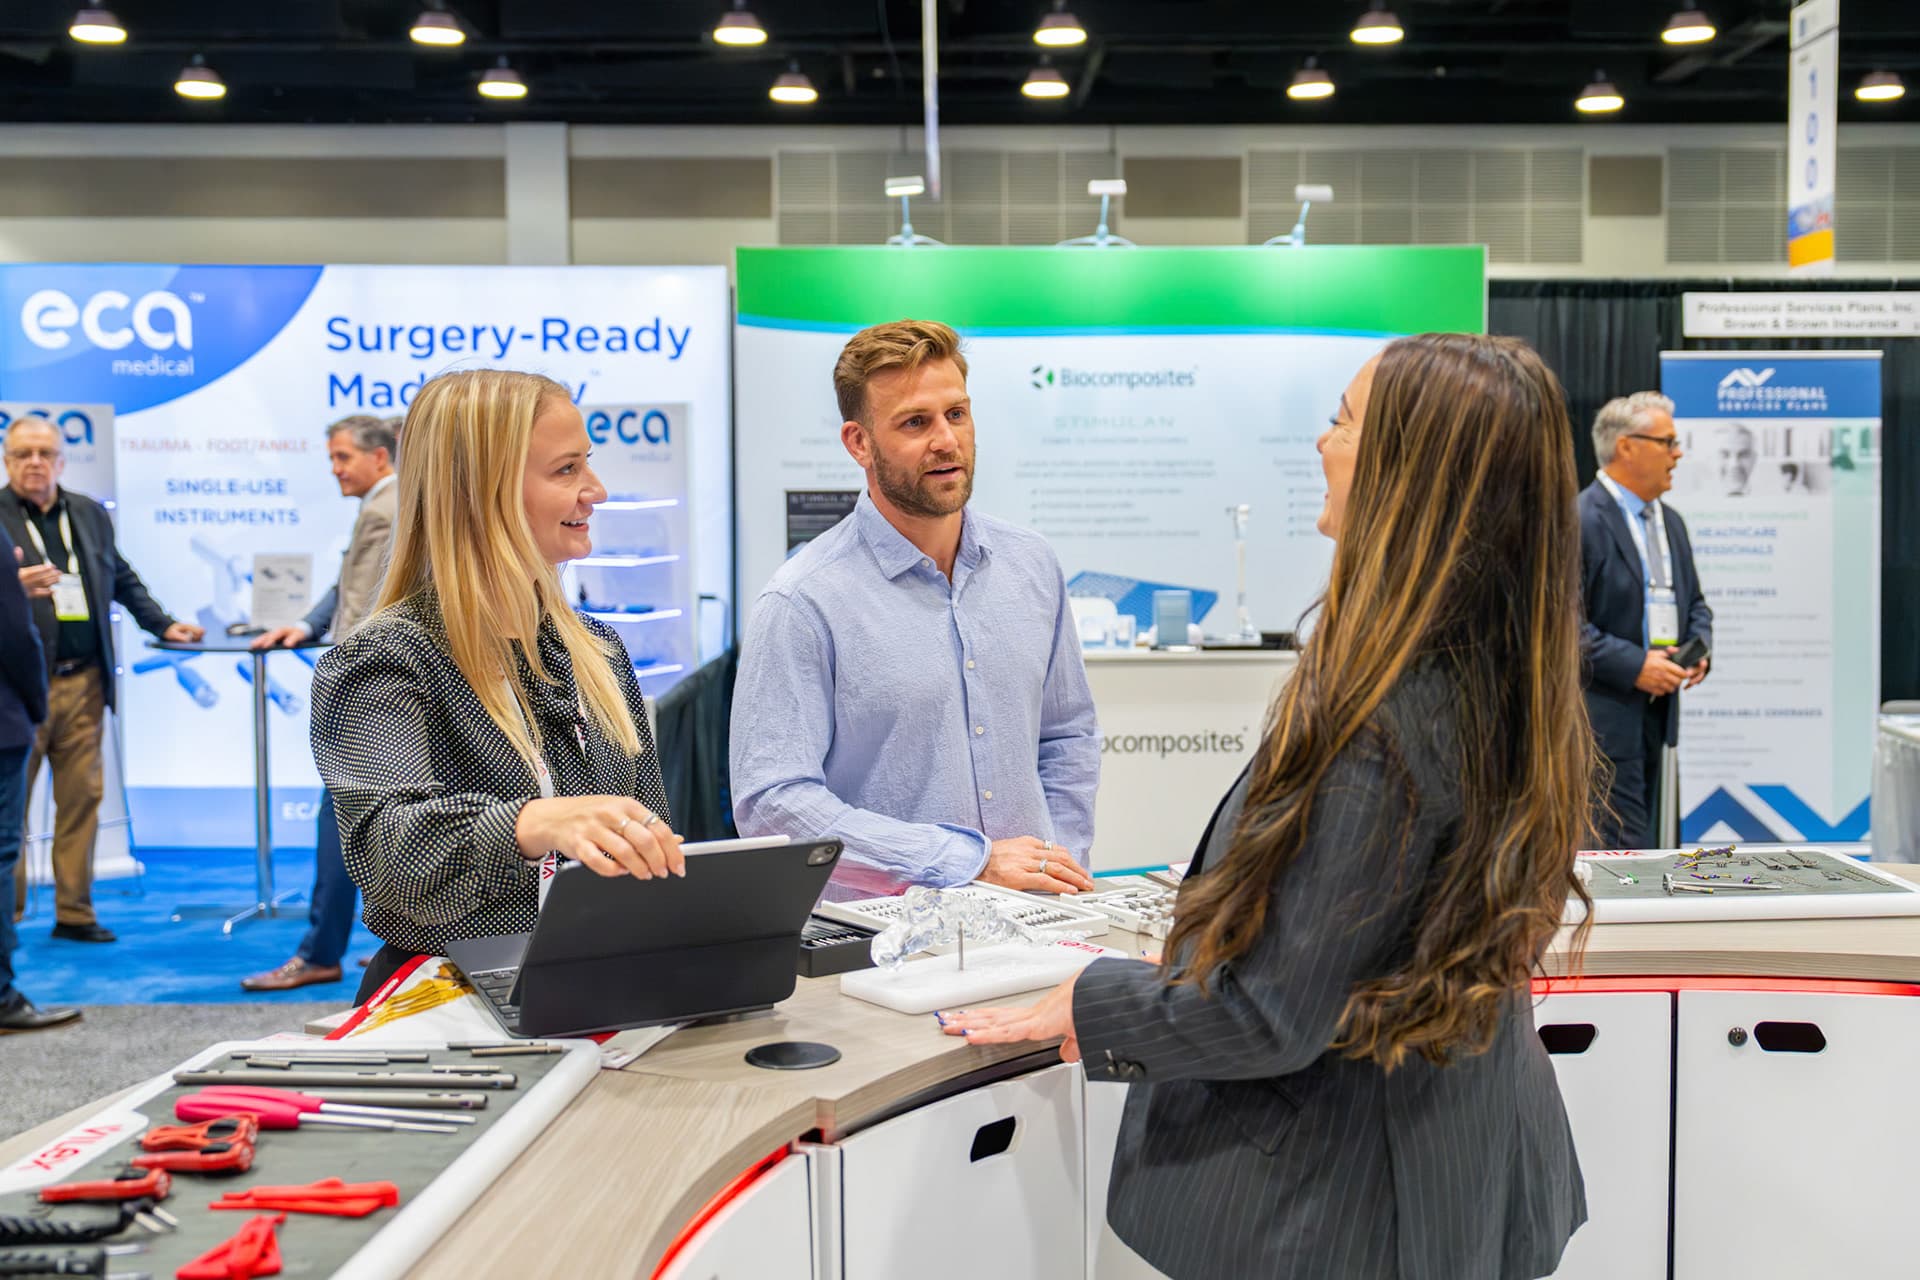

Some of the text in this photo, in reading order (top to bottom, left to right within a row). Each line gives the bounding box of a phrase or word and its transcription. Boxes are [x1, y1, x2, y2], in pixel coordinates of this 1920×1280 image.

[21, 290, 193, 350] eca
[327, 317, 691, 359] Surgery-Ready
[112, 353, 194, 376] medical
[329, 373, 425, 408] Mad
[1060, 368, 1196, 390] Biocomposites
[587, 410, 670, 444] eca
[166, 479, 287, 494] SINGLE-USE
[155, 509, 300, 524] INSTRUMENTS
[1101, 730, 1244, 758] ocomposites
